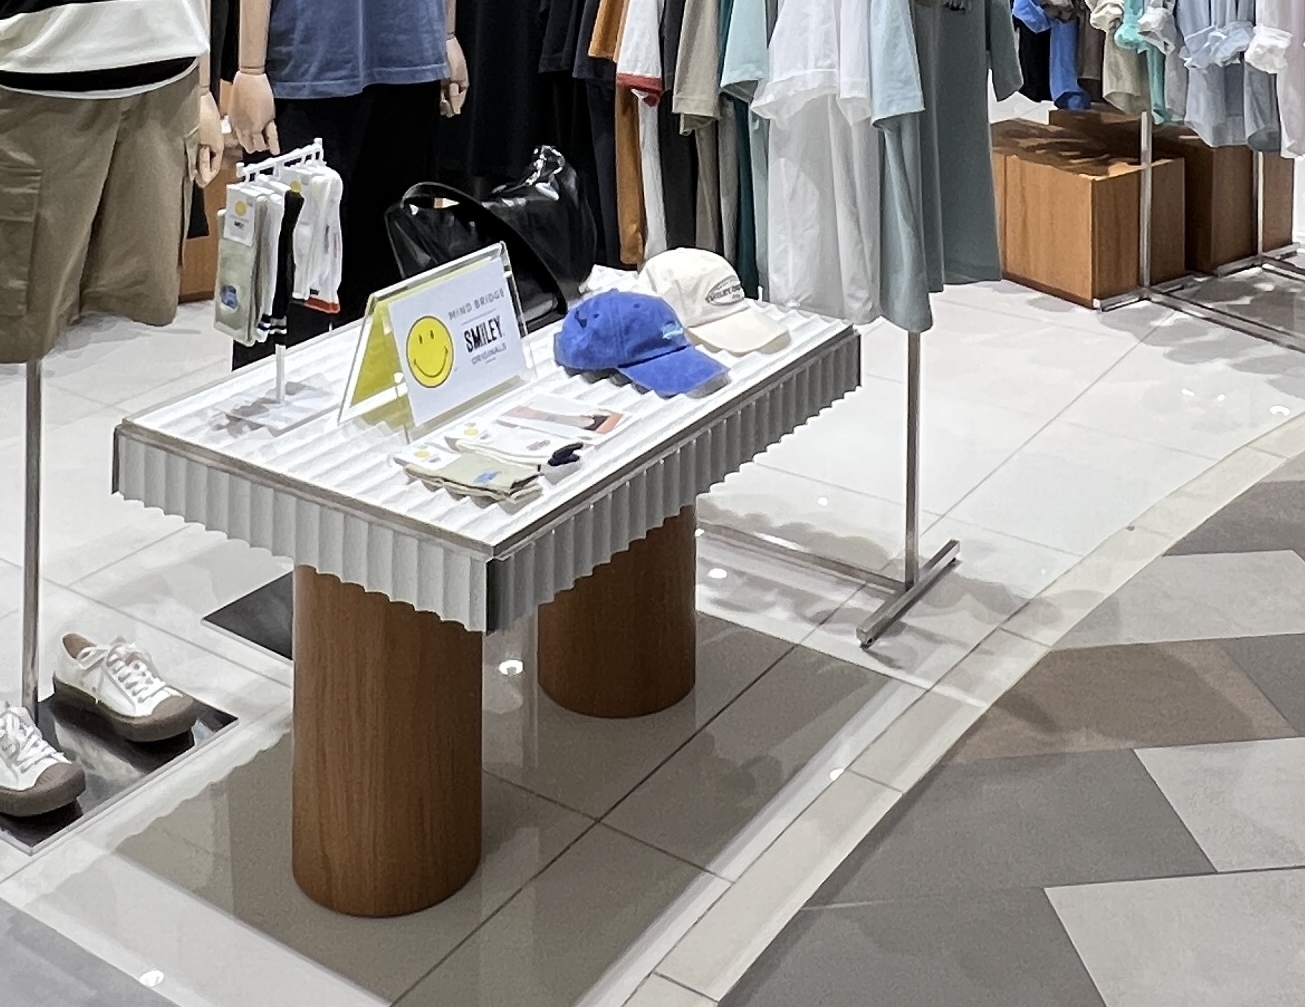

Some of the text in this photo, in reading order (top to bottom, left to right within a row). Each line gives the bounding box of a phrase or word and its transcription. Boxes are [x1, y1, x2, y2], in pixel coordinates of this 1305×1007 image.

[448, 287, 505, 320] MIND BRIDGE
[463, 314, 503, 353] SMILEY
[471, 342, 507, 365] ORIGINALS
